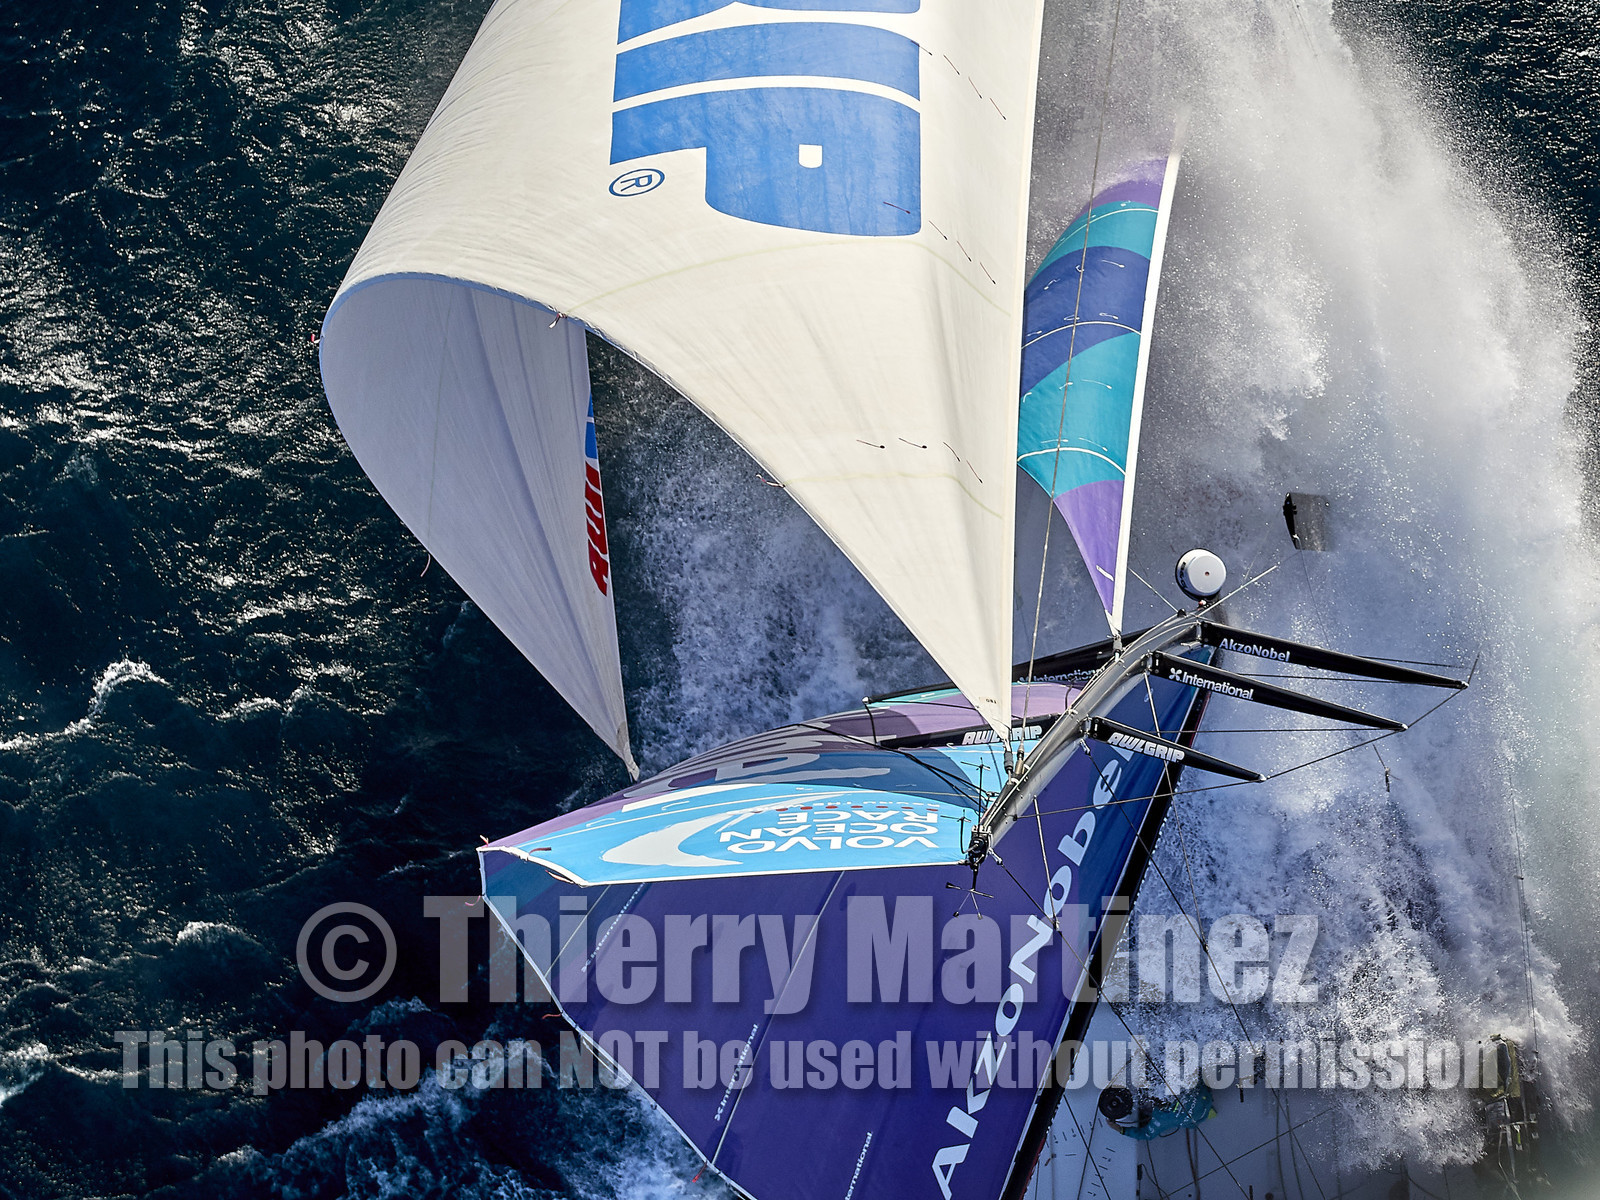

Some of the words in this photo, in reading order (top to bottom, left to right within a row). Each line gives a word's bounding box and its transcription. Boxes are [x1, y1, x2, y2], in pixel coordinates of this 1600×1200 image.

[1219, 637, 1291, 662] AkzoNobel
[1183, 671, 1254, 700] International
[962, 725, 1043, 746] AWLRIP
[1107, 731, 1185, 762] AWLGRIP
[777, 809, 938, 825] RACE
[719, 822, 939, 843] OCEAN
[727, 835, 940, 854] VOLVO
